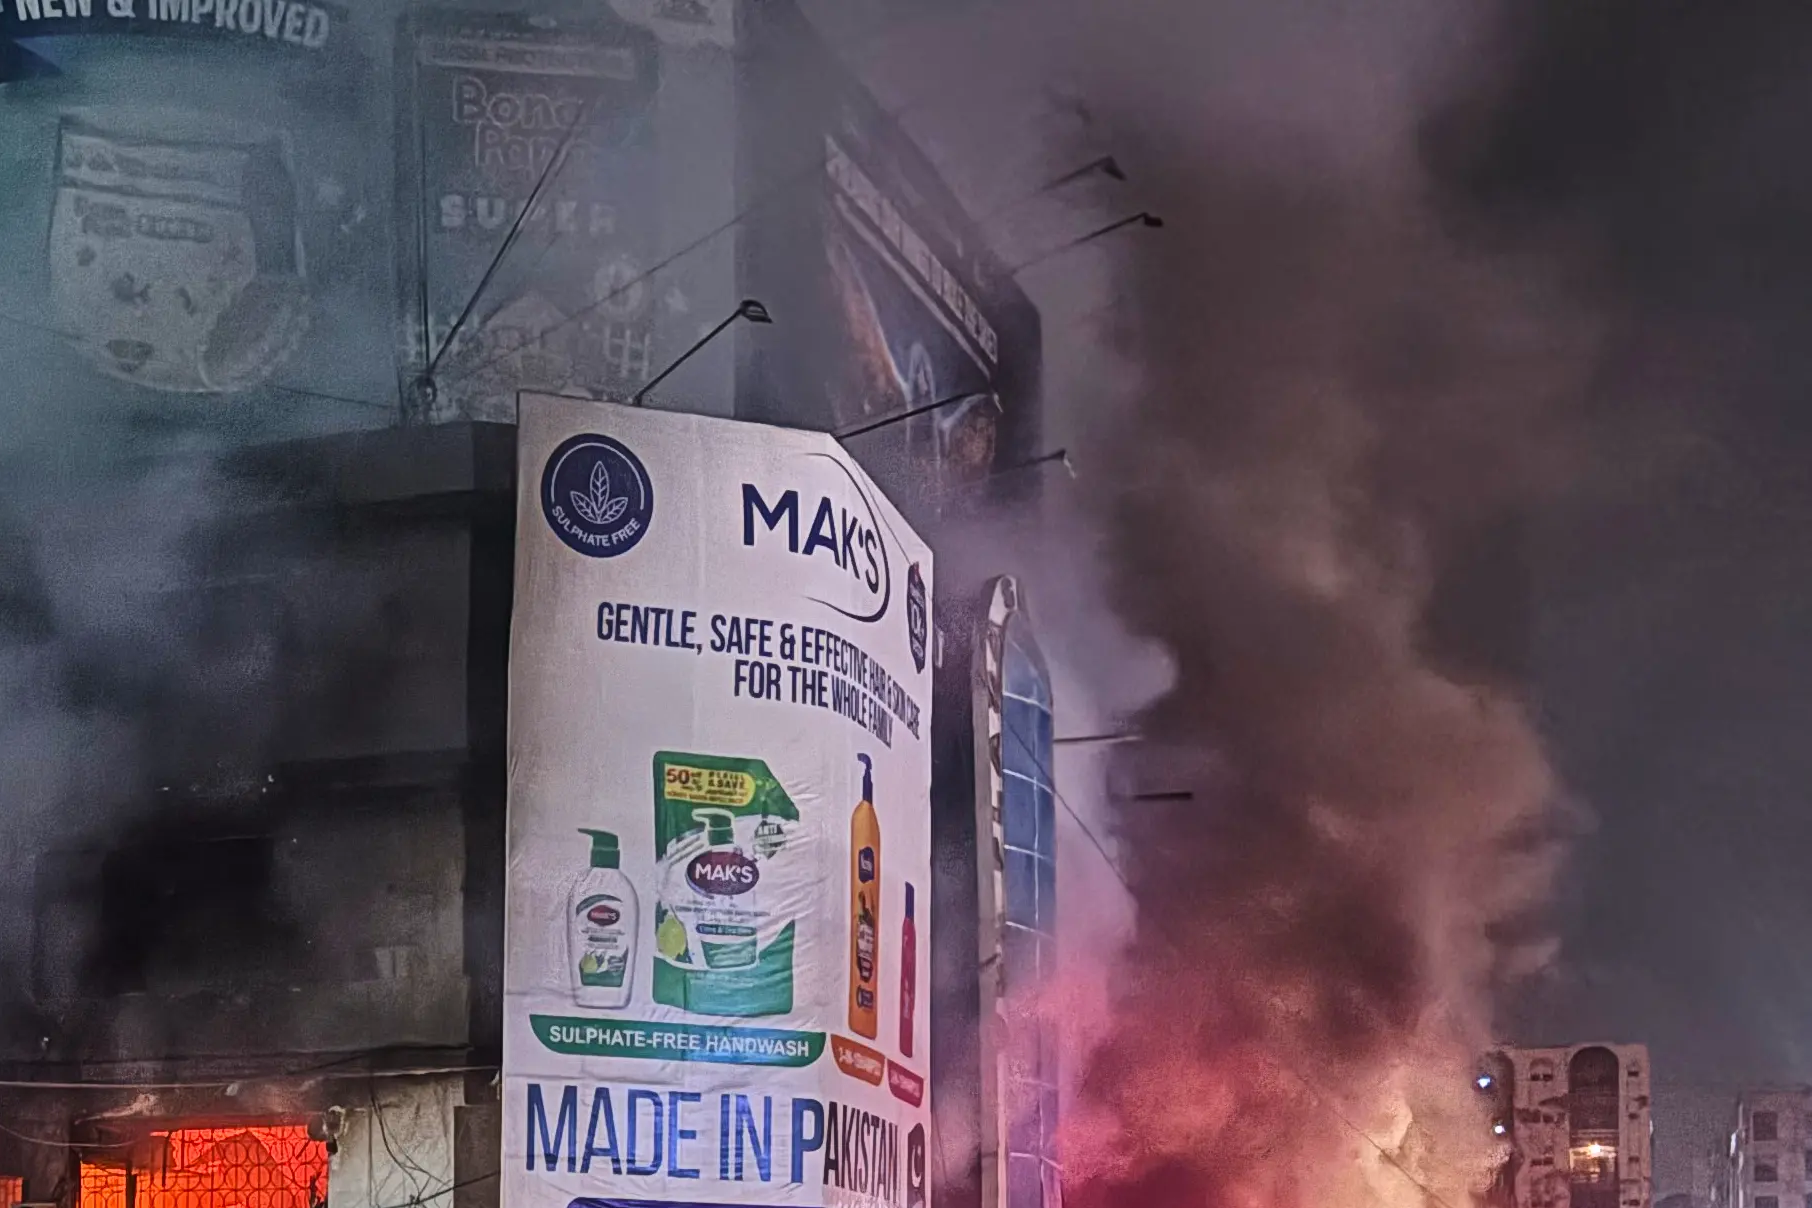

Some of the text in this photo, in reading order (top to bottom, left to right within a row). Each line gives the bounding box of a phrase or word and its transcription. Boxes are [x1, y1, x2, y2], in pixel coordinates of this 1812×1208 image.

[148, 0, 330, 49] IMPROVED
[551, 505, 641, 547] SULPHATE FREE
[742, 483, 881, 595] MAK'S
[596, 602, 702, 656] GENTLE,
[710, 614, 773, 658] SAFE
[779, 623, 796, 661] &
[801, 626, 868, 689] EFFECTIVE
[734, 659, 782, 701] FOR
[787, 666, 828, 708] THE
[831, 674, 867, 729] WHOLE
[694, 863, 753, 883] MAK'S
[549, 1024, 810, 1058] SULPHATE-FREE HANDWASH
[525, 1083, 899, 1203] MADE IN PAKISTAN
